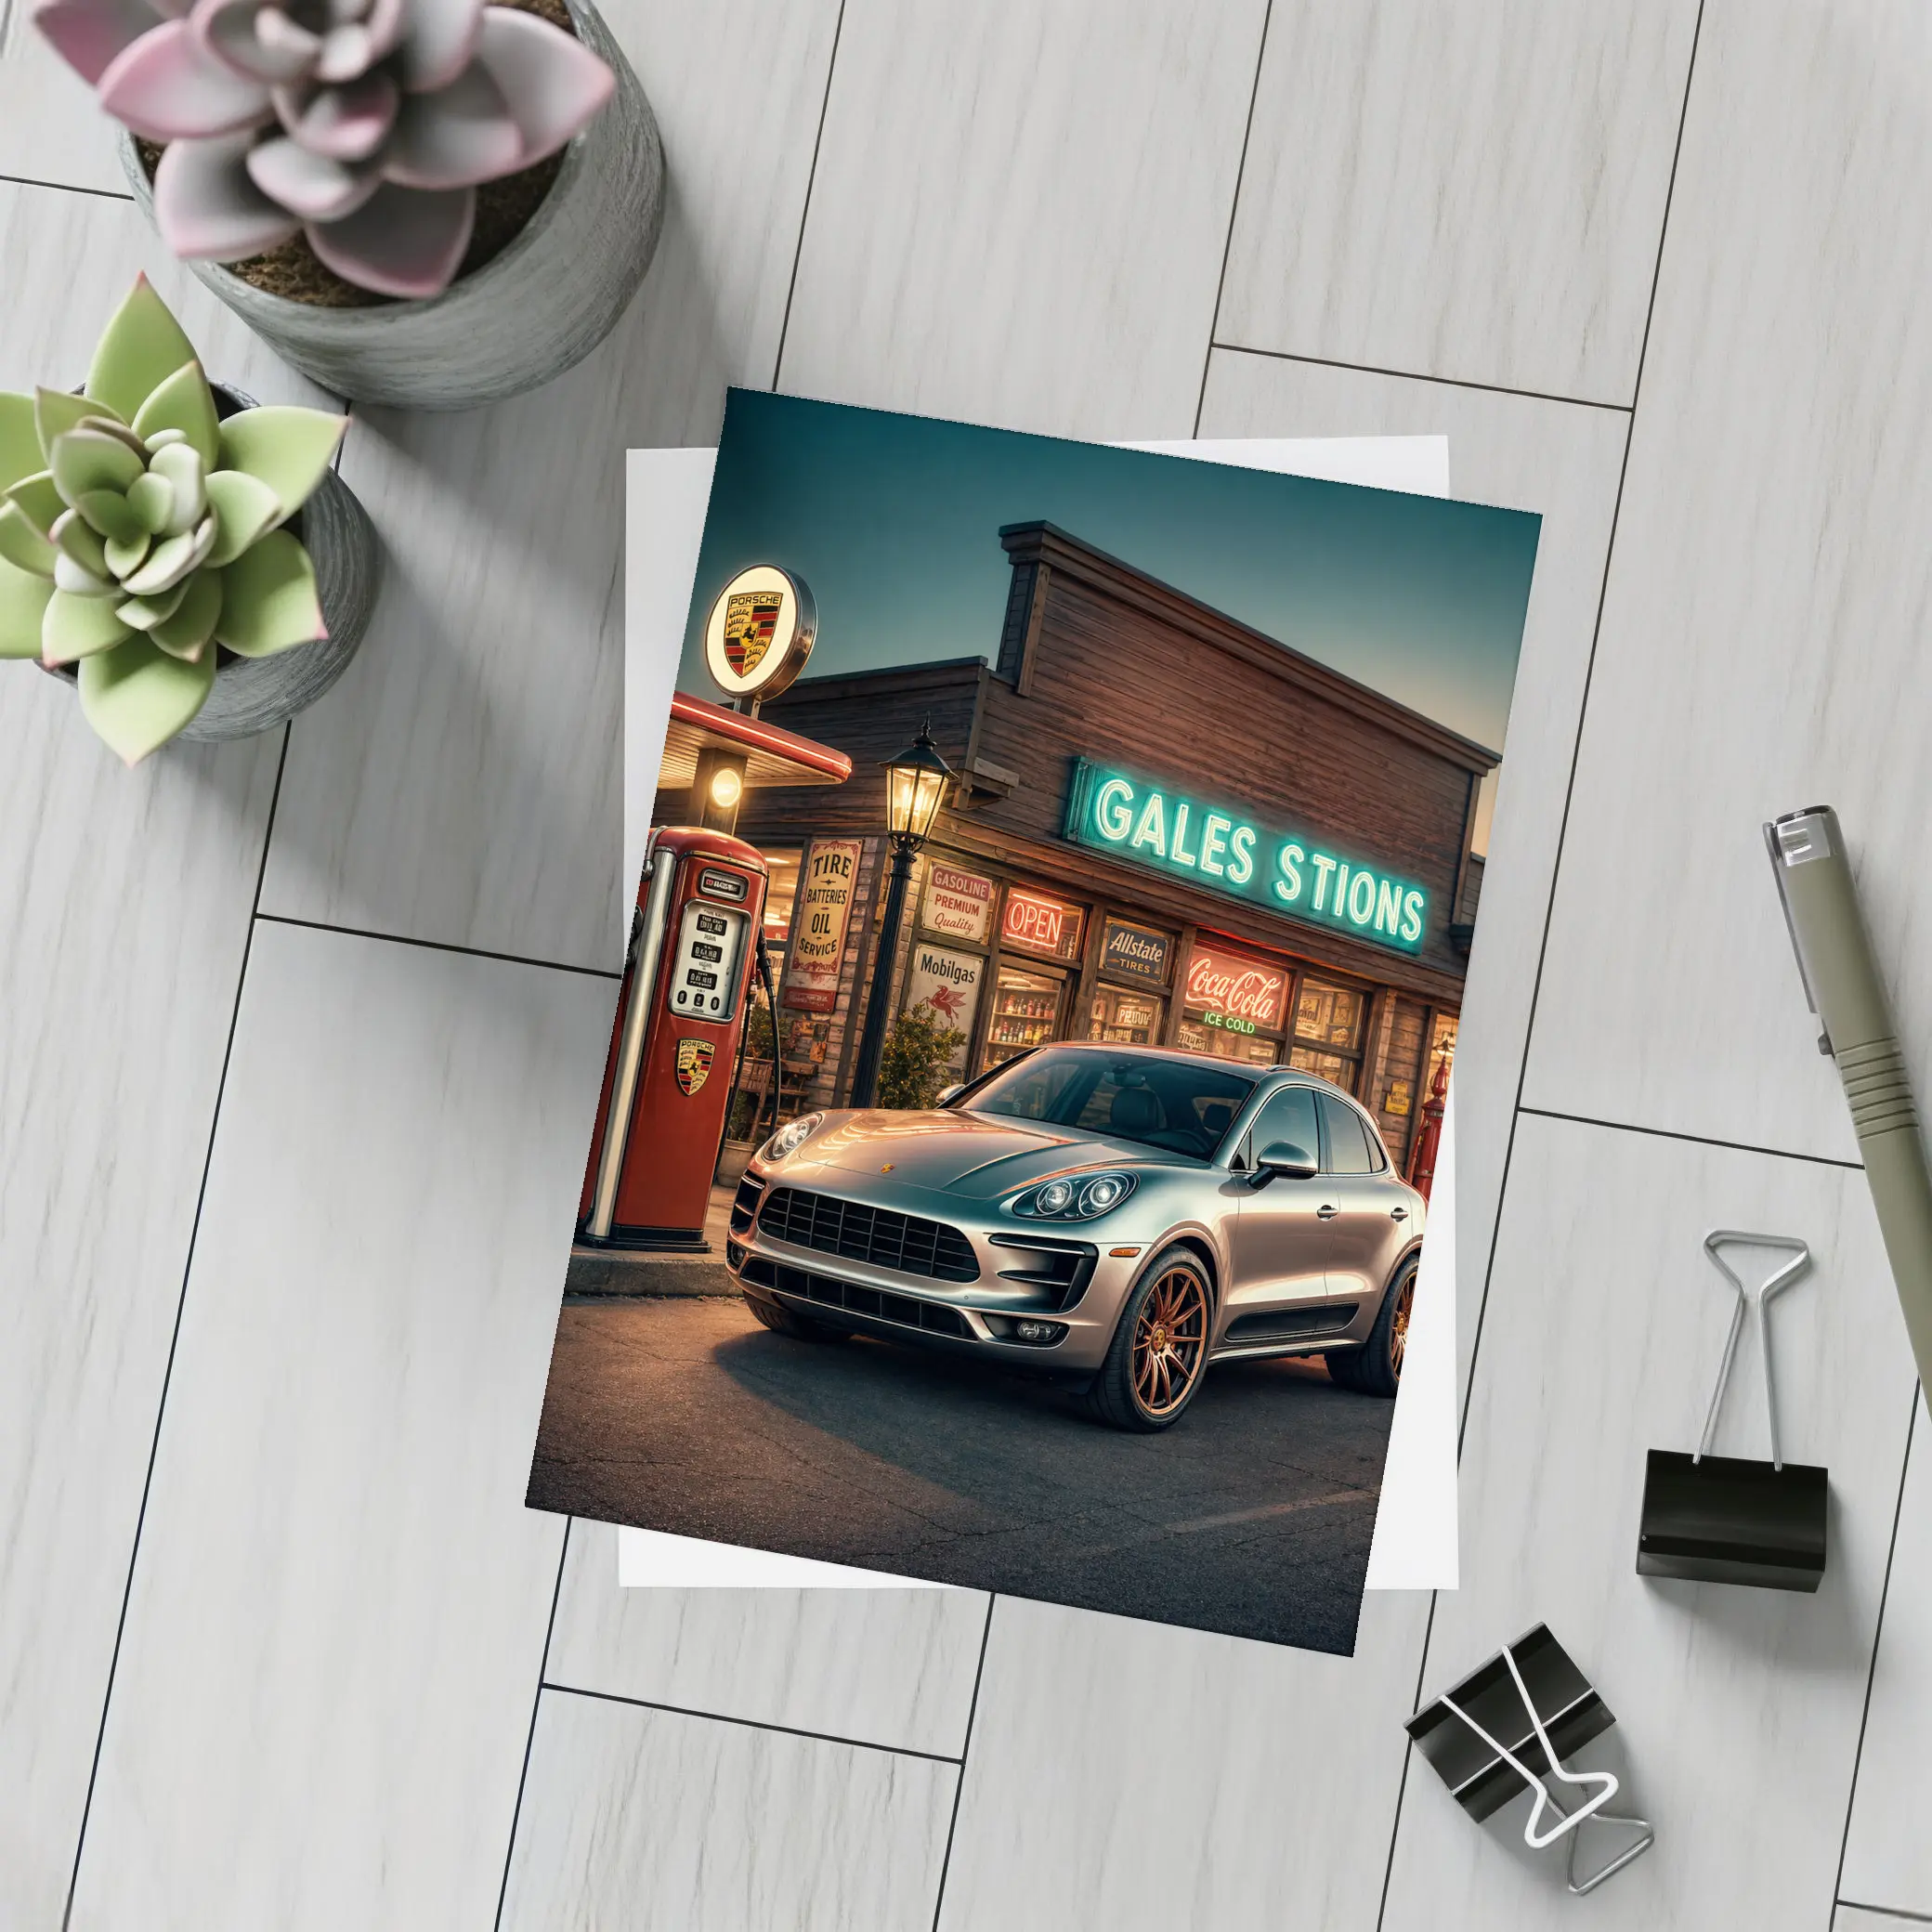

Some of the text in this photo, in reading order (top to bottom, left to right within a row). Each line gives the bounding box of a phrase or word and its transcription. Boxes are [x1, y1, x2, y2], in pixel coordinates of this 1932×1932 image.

[730, 595, 779, 607] PORSCHE
[814, 854, 852, 879] TIRE
[1096, 779, 1424, 941] GALES STIONS
[934, 871, 987, 897] GASOLINE
[806, 889, 847, 905] BATTERIES
[934, 894, 980, 916] PREMIUM
[811, 913, 830, 933] OIL
[934, 912, 974, 934] Quality
[1011, 902, 1063, 942] OPEN
[799, 937, 837, 957] SERVICE
[1109, 932, 1163, 963] Allstate
[920, 953, 975, 985] Mobilgas
[1119, 958, 1151, 974] TIRES
[1204, 1012, 1255, 1034] ICE COLD
